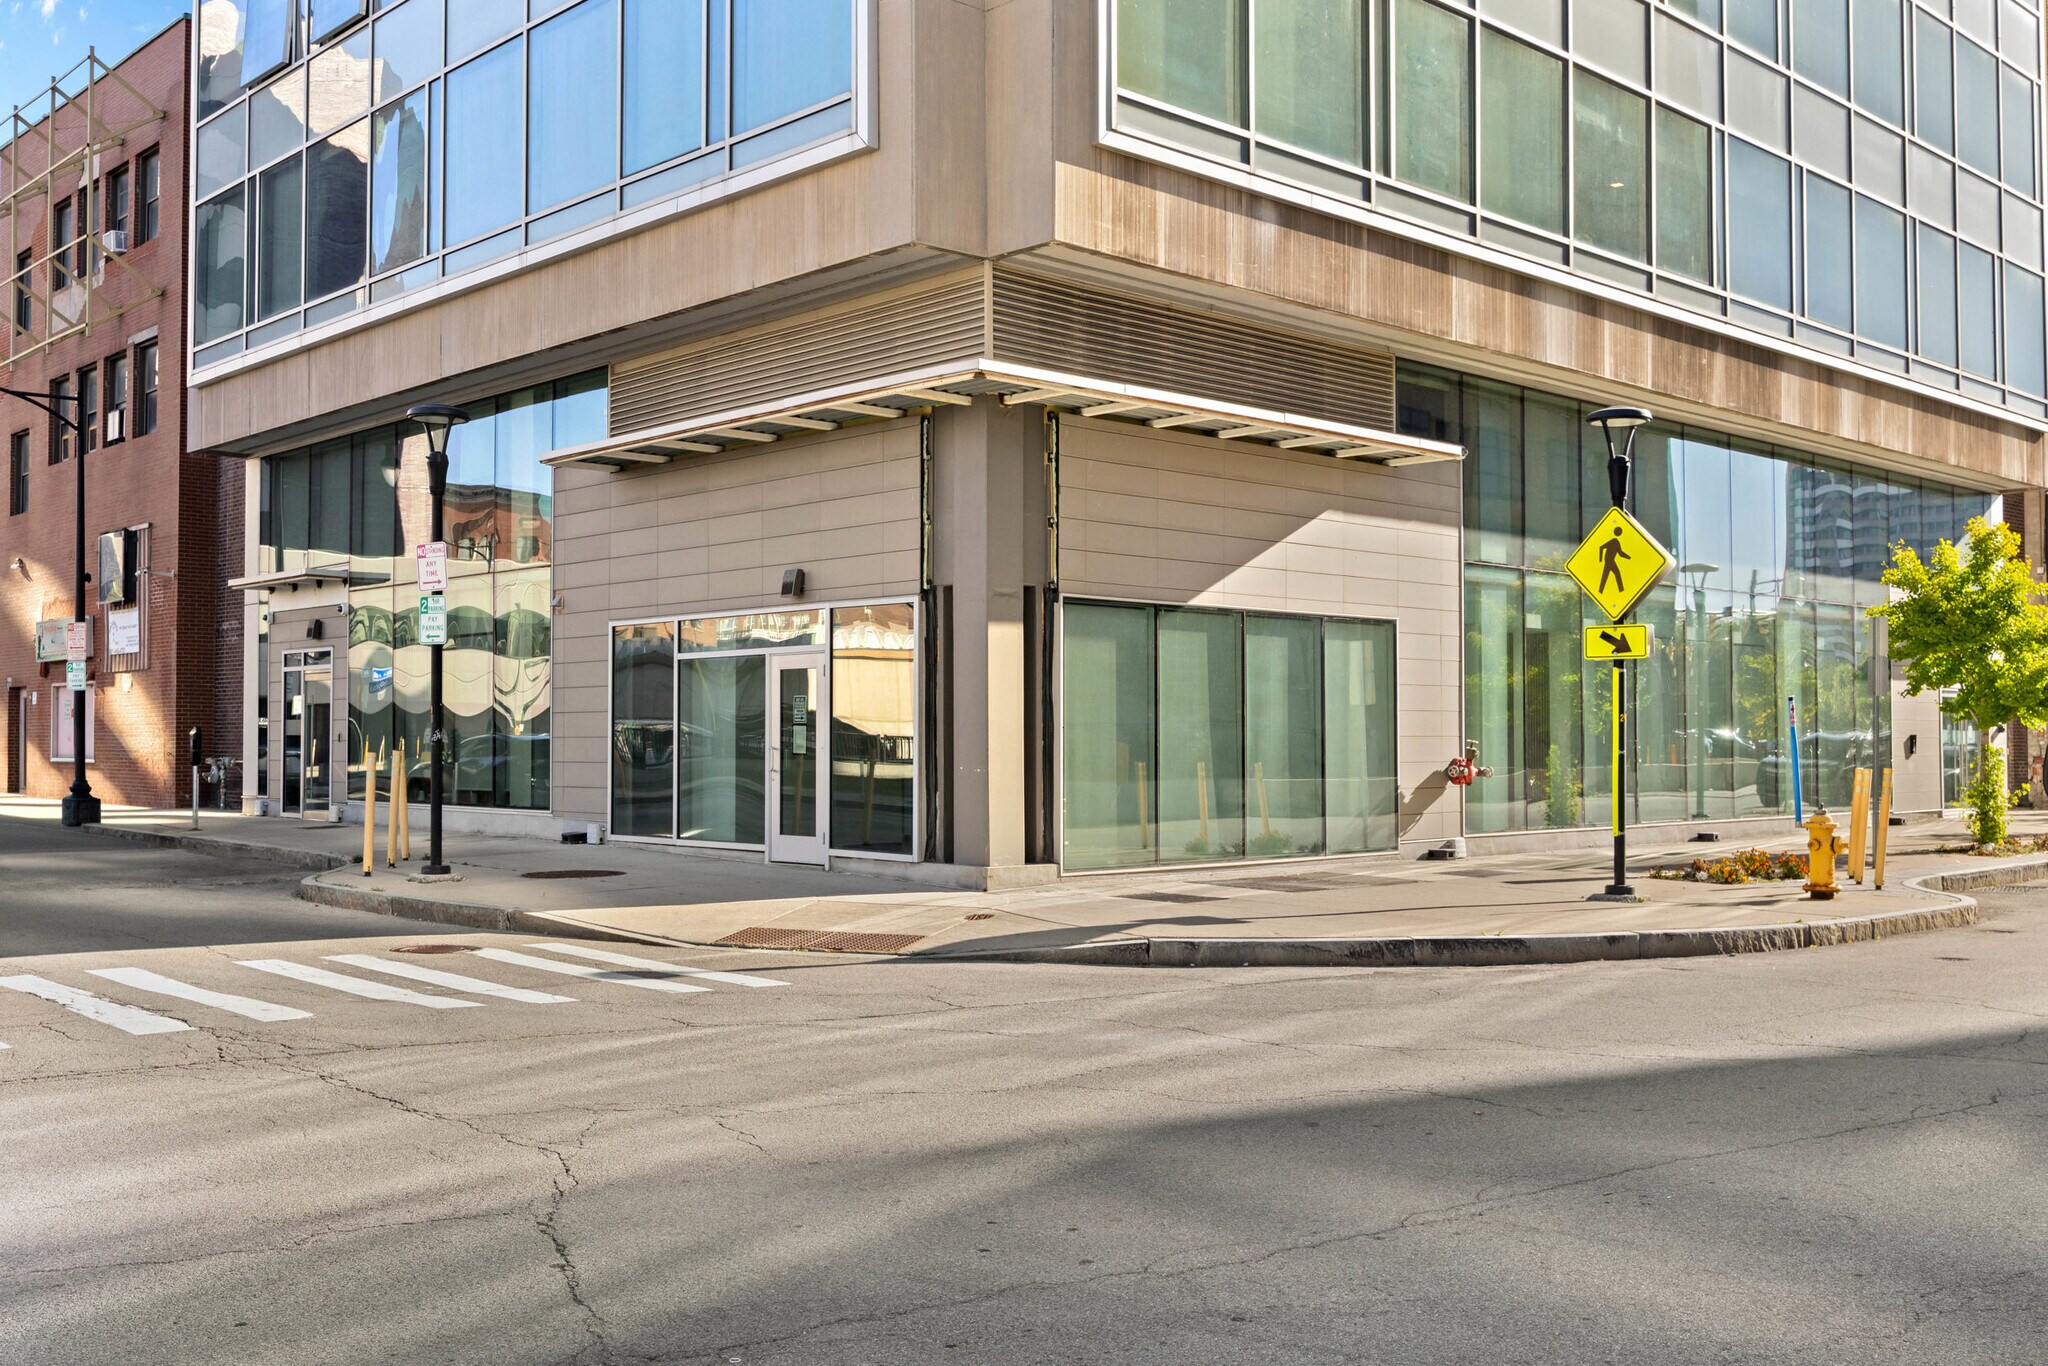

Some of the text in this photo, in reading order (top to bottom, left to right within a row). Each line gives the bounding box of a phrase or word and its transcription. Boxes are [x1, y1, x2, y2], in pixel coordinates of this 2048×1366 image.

[417, 547, 426, 557] NO
[421, 599, 428, 612] 2
[421, 624, 444, 632] PARKING
[67, 662, 73, 672] 2
